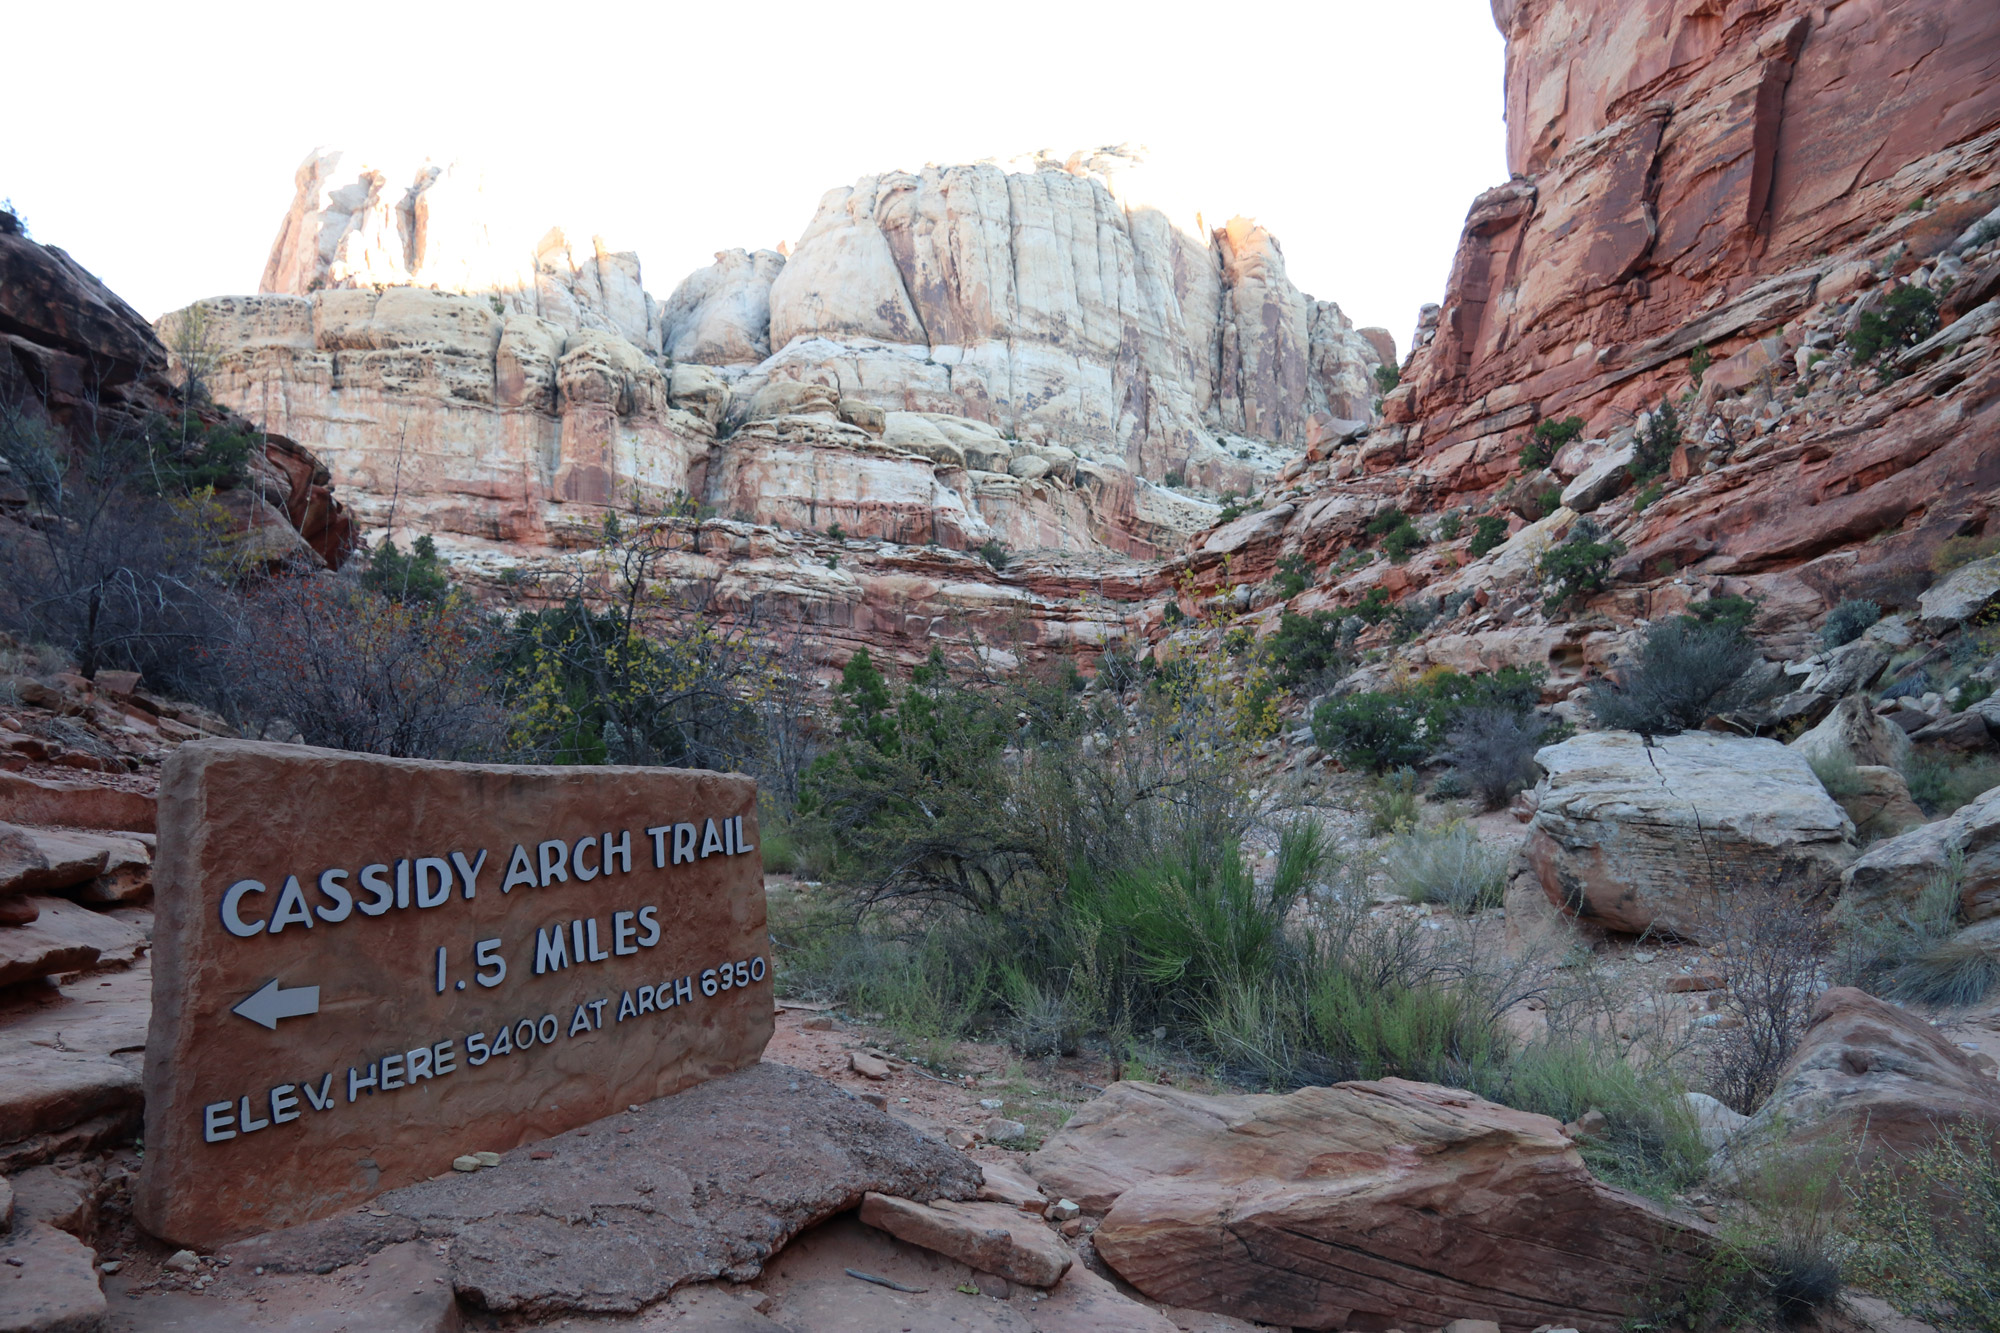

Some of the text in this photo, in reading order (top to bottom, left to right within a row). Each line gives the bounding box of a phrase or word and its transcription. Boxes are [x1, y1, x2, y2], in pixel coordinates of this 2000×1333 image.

[220, 815, 754, 937] CASSIDY ARCH TRAIL
[436, 905, 661, 994] 1.5 MILES
[204, 956, 766, 1143] ELEV. HERE 5400 AT ARCH 6350
